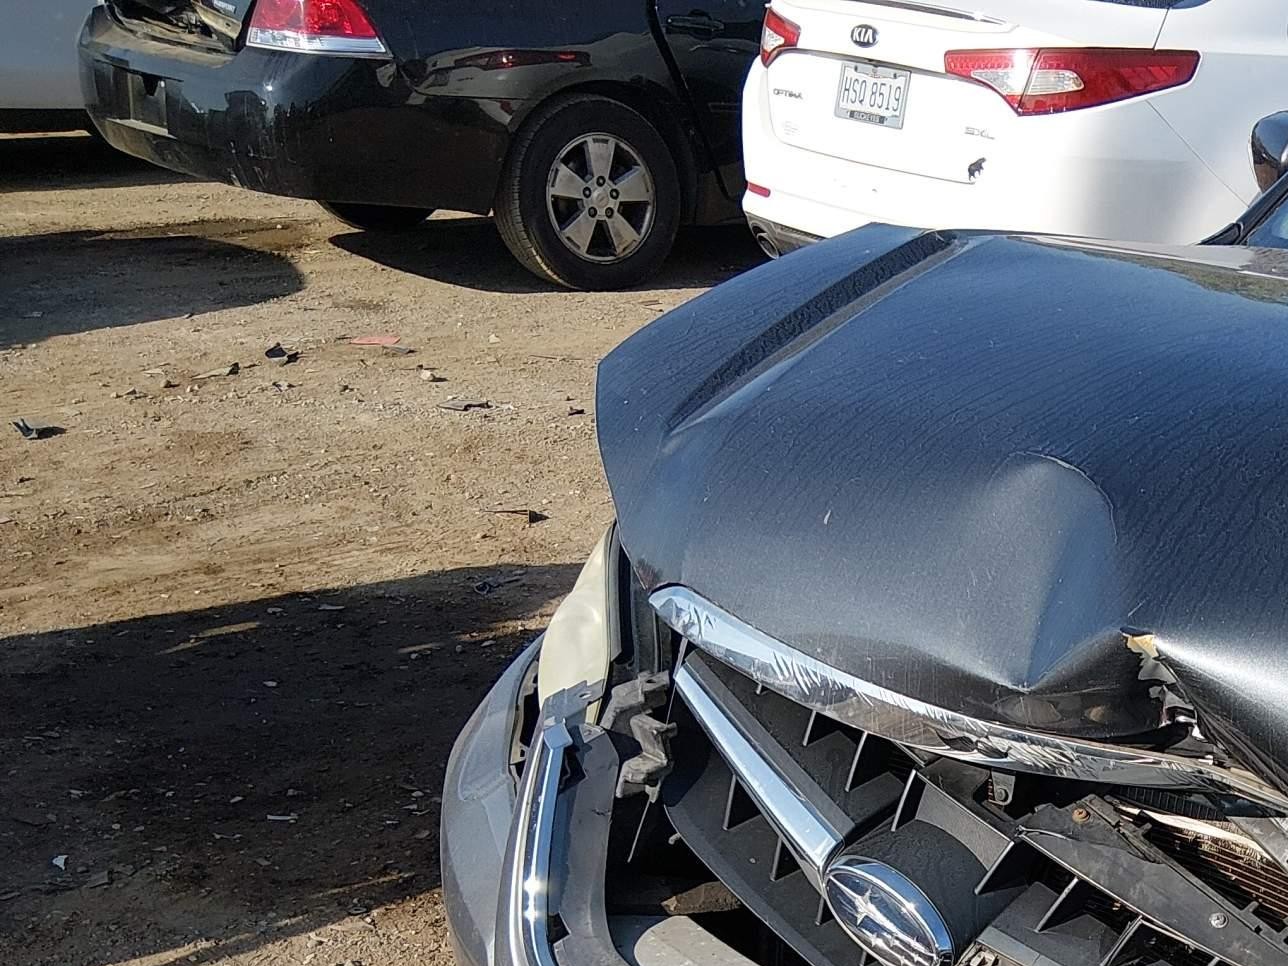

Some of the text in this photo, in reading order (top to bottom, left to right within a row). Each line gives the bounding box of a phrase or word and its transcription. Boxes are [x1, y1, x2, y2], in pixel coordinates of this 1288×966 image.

[852, 27, 874, 44] KIA
[842, 76, 902, 112] HSQ 8519
